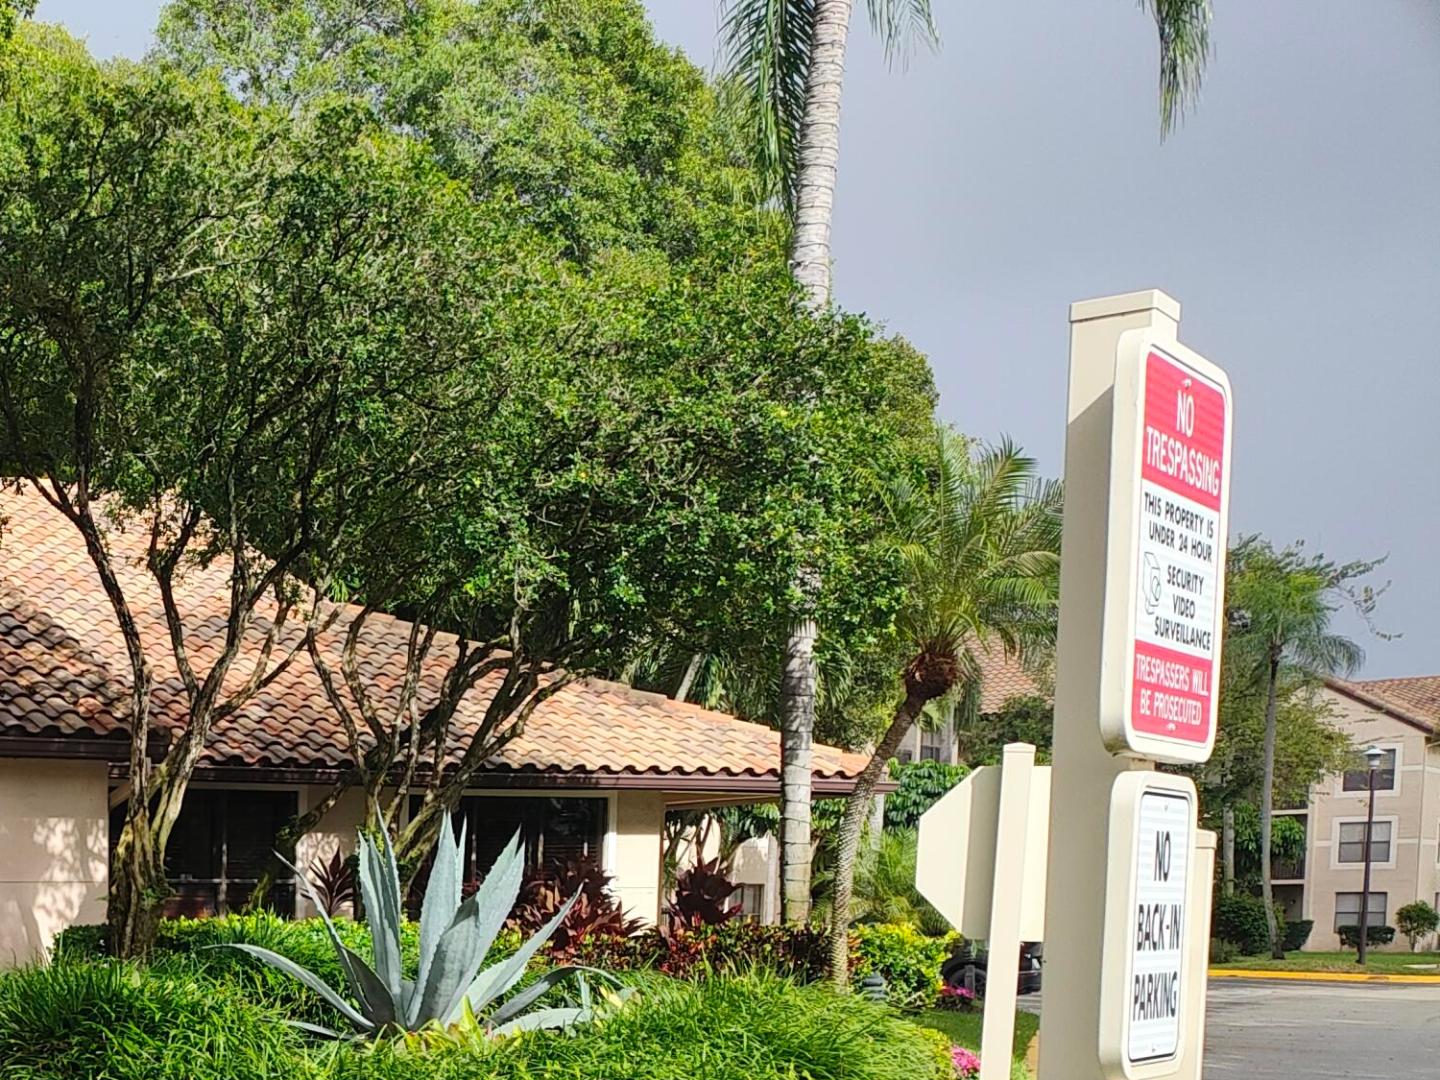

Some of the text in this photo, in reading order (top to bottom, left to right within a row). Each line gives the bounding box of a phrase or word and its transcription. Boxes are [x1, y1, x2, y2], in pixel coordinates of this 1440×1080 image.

[1176, 389, 1194, 437] NO
[1146, 426, 1220, 496] TRESPASSING
[1145, 492, 1214, 539] THIS PROPERTY IS
[1149, 520, 1212, 563] UNDER 24 HOUR
[1167, 564, 1204, 595] SECURITY
[1173, 594, 1196, 620] VIDEO
[1154, 616, 1211, 650] SURVEILLANCE
[1136, 653, 1209, 696] TRESPASSERS WILL
[1140, 688, 1202, 725] BE PROSECUTED
[1154, 830, 1171, 882] NO
[1137, 904, 1181, 951] BACK-IN
[1133, 971, 1178, 1022] PARKING
